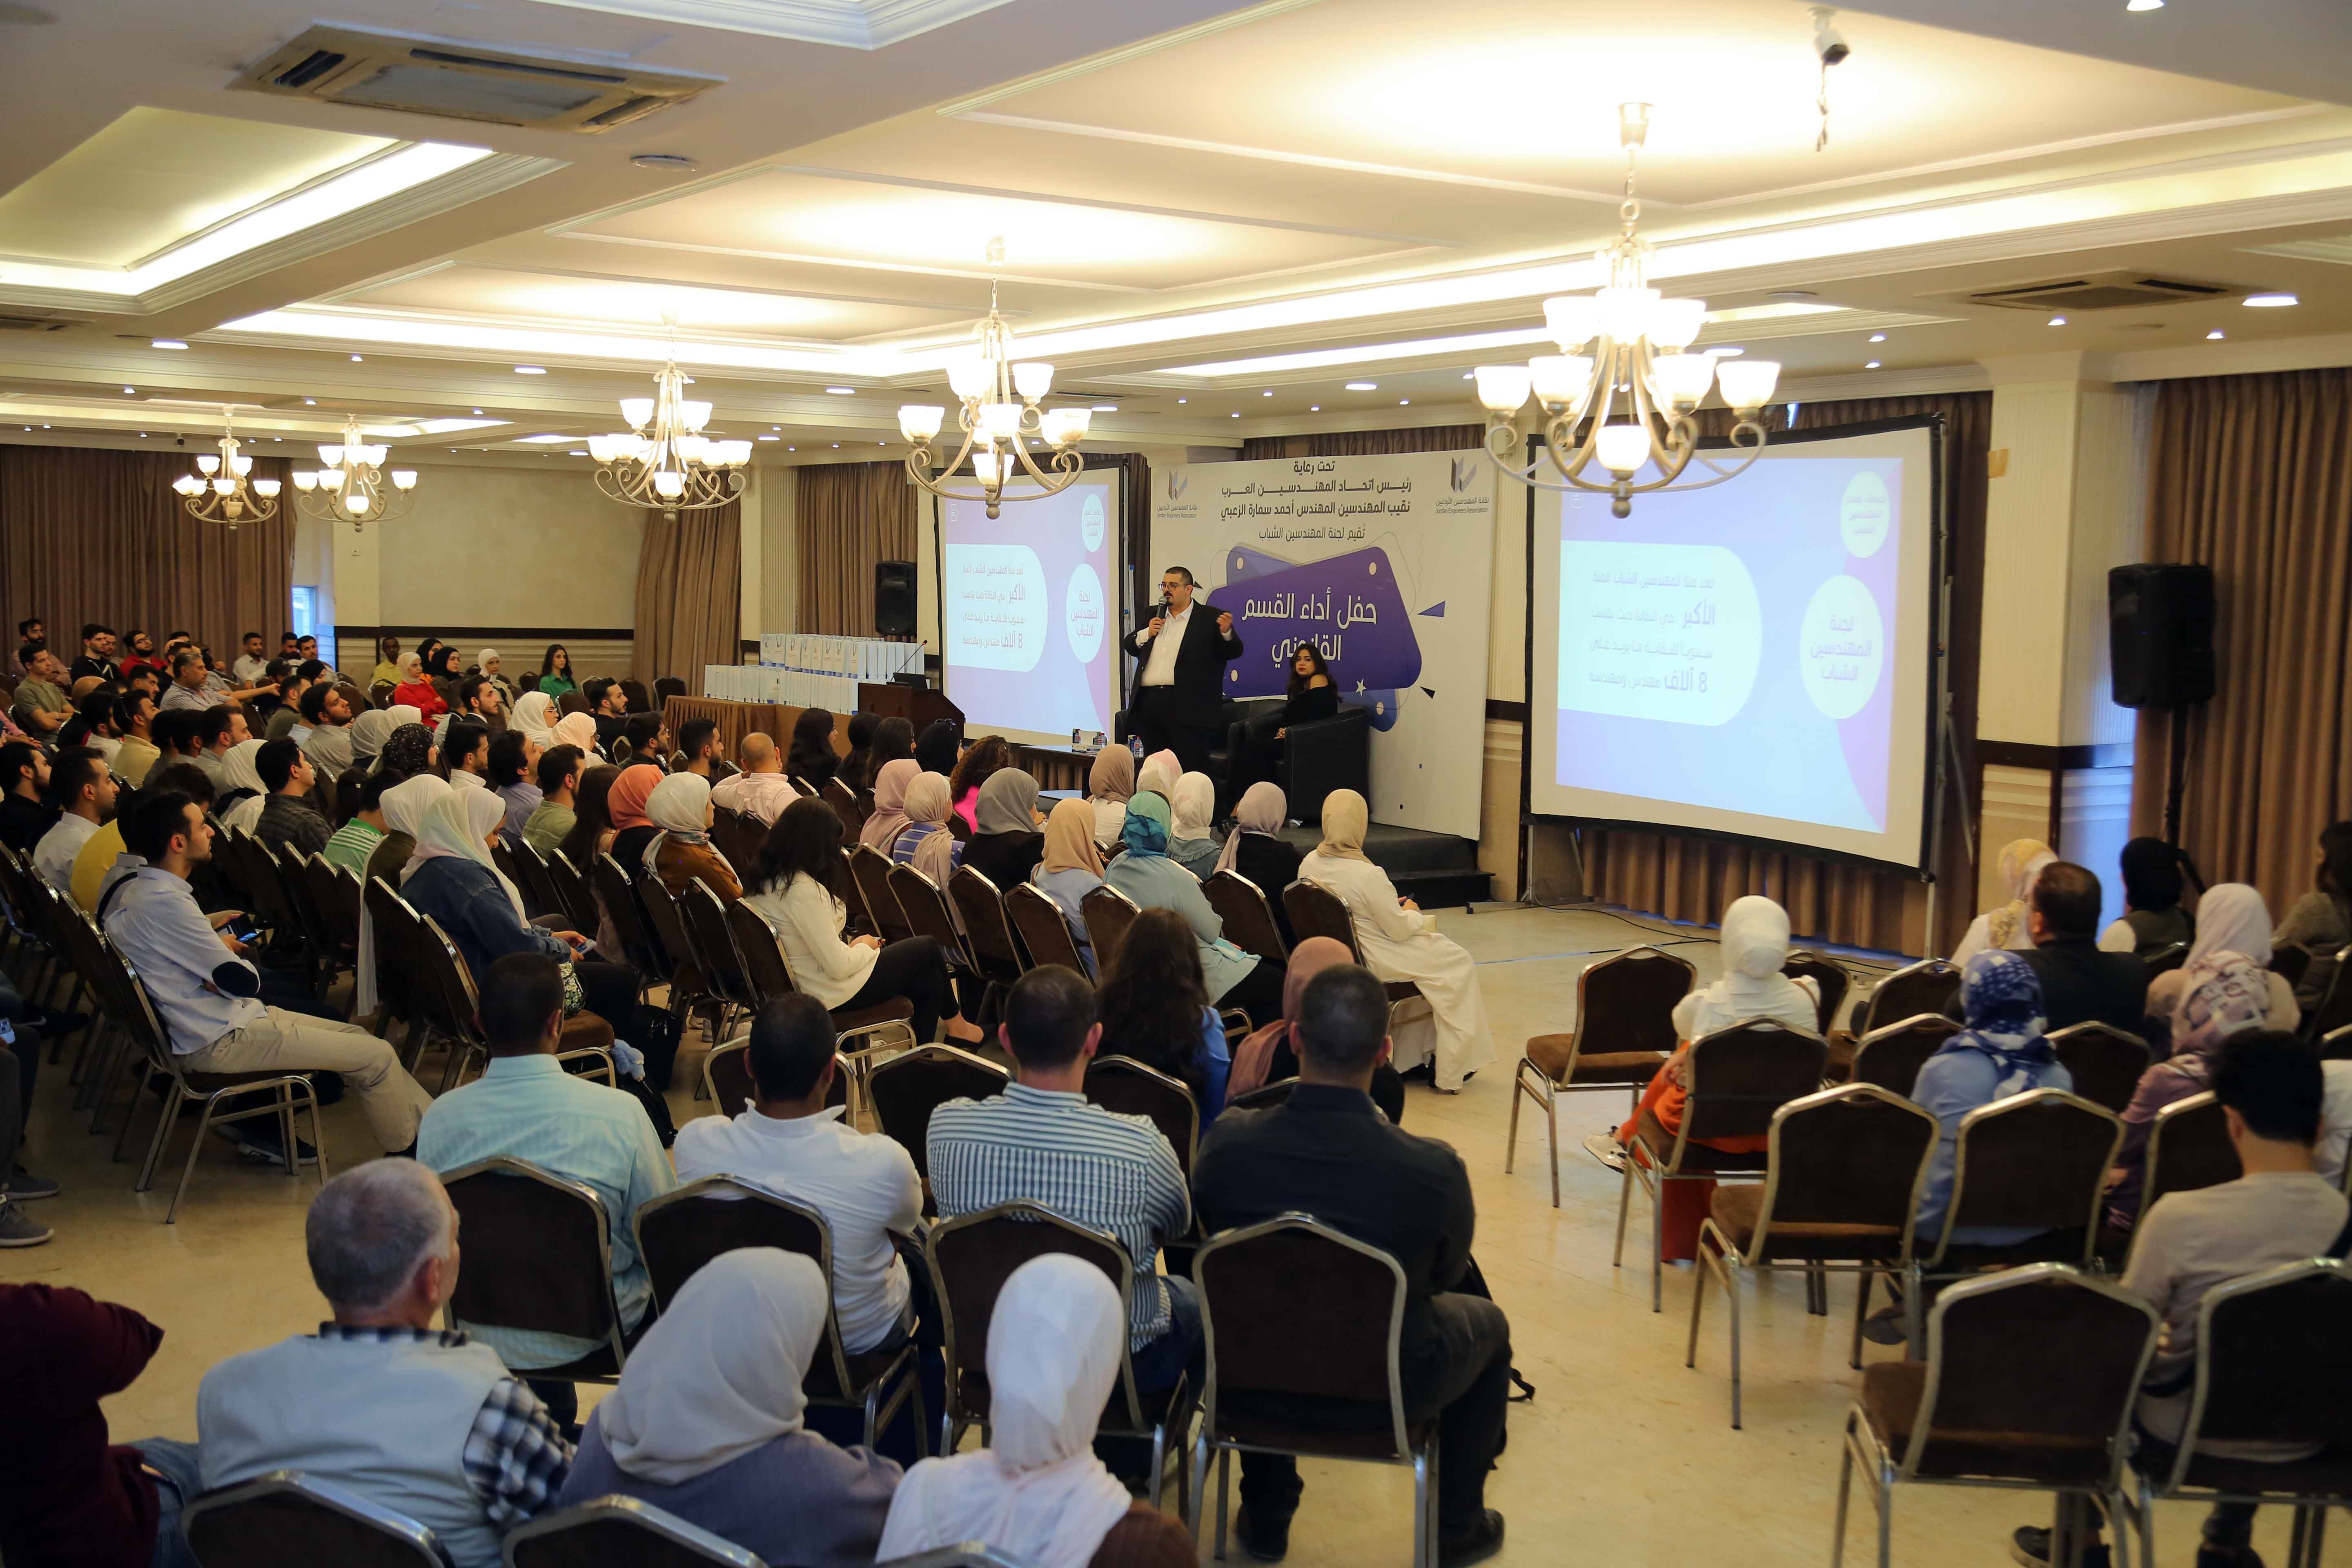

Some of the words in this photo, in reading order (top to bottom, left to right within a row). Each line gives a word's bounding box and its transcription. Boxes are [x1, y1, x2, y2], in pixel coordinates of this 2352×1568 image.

[1294, 461, 1314, 475] رعاية
[1317, 461, 1335, 472] تحت
[1221, 503, 1245, 521] الزعبي
[1249, 503, 1271, 517] سمارة
[1274, 499, 1294, 514] أحمد
[1297, 501, 1335, 517] المهندس
[1339, 501, 1385, 517] المهندسين
[1388, 500, 1410, 516] نقيب
[1259, 526, 1283, 541] الشباب
[1286, 527, 1325, 541] المهندسين
[1328, 527, 1344, 541] لجنة
[1009, 581, 1025, 604] الأكبر
[1079, 590, 1090, 604] لجنة
[1242, 593, 1294, 621] القسم
[1300, 587, 1331, 620] أداء
[1071, 608, 1099, 621] المهندسين
[1337, 595, 1376, 629] حفل
[1682, 598, 1715, 629] الأكبر
[1076, 624, 1094, 639] الشباب
[1018, 633, 1023, 648] 8
[1699, 671, 1708, 693] 8
